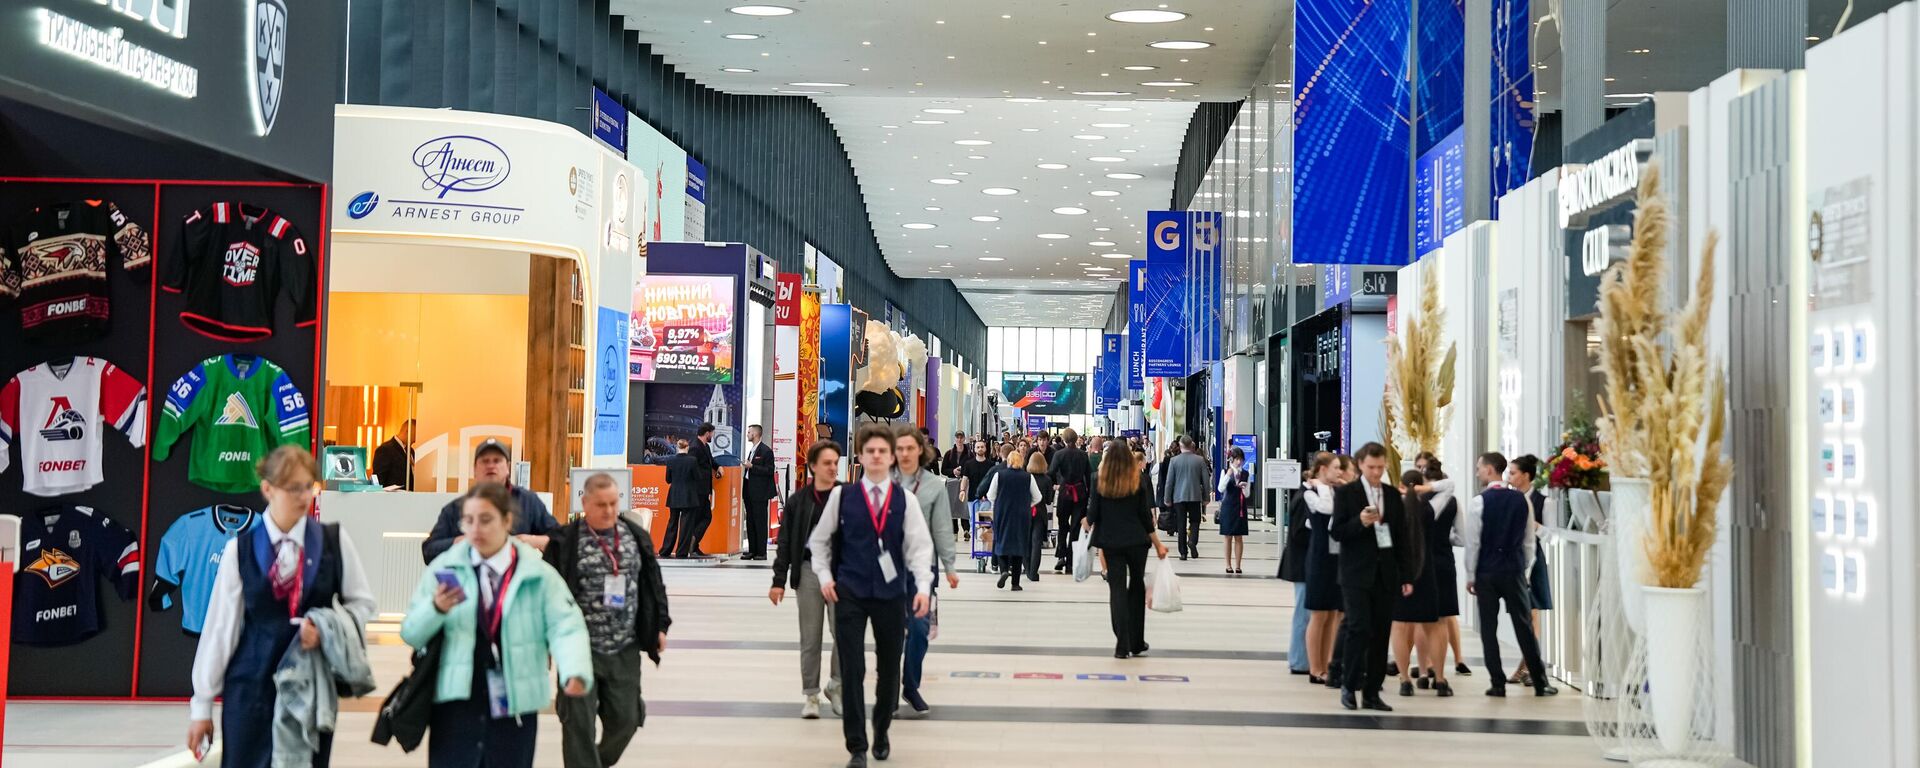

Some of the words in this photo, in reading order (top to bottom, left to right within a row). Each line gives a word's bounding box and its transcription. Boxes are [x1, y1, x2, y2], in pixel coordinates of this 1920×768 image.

[392, 206, 462, 220] ARNEST
[471, 211, 521, 225] GROUP
[1153, 220, 1180, 251] G
[225, 247, 260, 268] OVER
[1582, 224, 1610, 277] CLUB
[222, 263, 257, 283] TIME
[645, 283, 712, 303] НИЖНИЙ
[646, 302, 728, 322] НОВГОРОД
[667, 328, 700, 341] 8,97%
[1108, 338, 1117, 353] E
[656, 353, 678, 364] 690
[679, 354, 708, 366] 300,3
[1132, 351, 1140, 378] LUNCH
[172, 377, 193, 400] 56
[281, 391, 306, 413] 56
[38, 459, 87, 473] FONBET
[36, 604, 77, 622] FONBET
